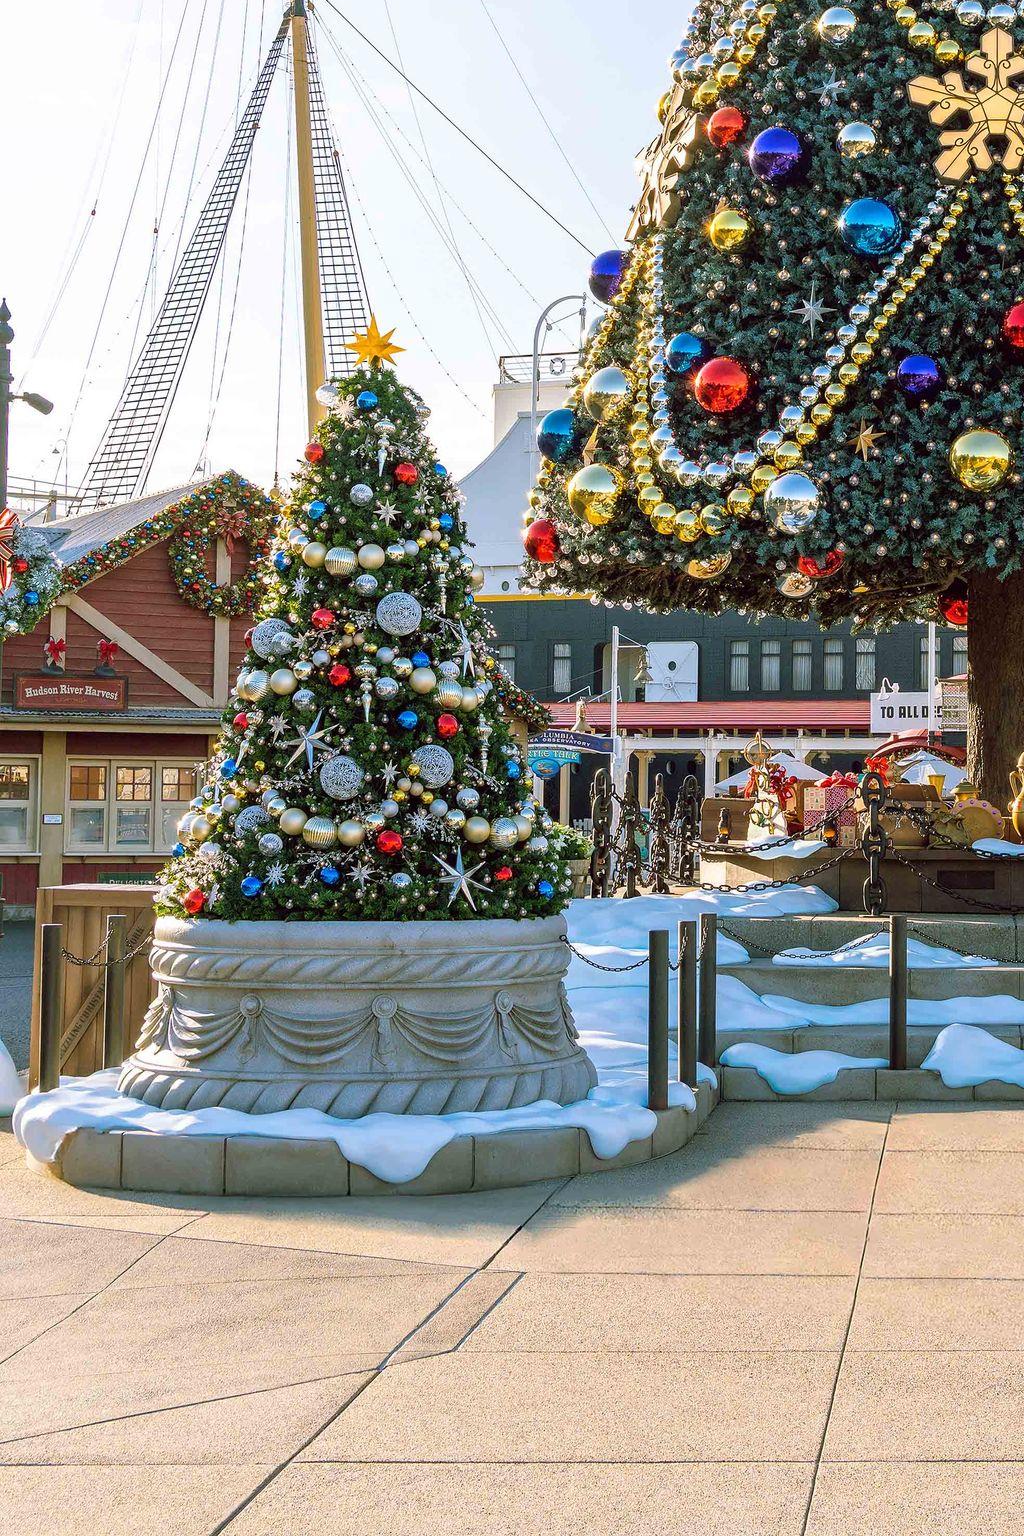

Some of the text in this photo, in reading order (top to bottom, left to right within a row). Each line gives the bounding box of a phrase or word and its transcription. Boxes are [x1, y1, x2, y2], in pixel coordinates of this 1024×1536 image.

[25, 684, 119, 701] Hudson River Harvest
[881, 706, 894, 719] TO
[899, 706, 919, 719] ALL
[541, 732, 575, 740] LUMBIA
[542, 738, 591, 747] OBSERVATORY
[553, 750, 578, 760] TALK
